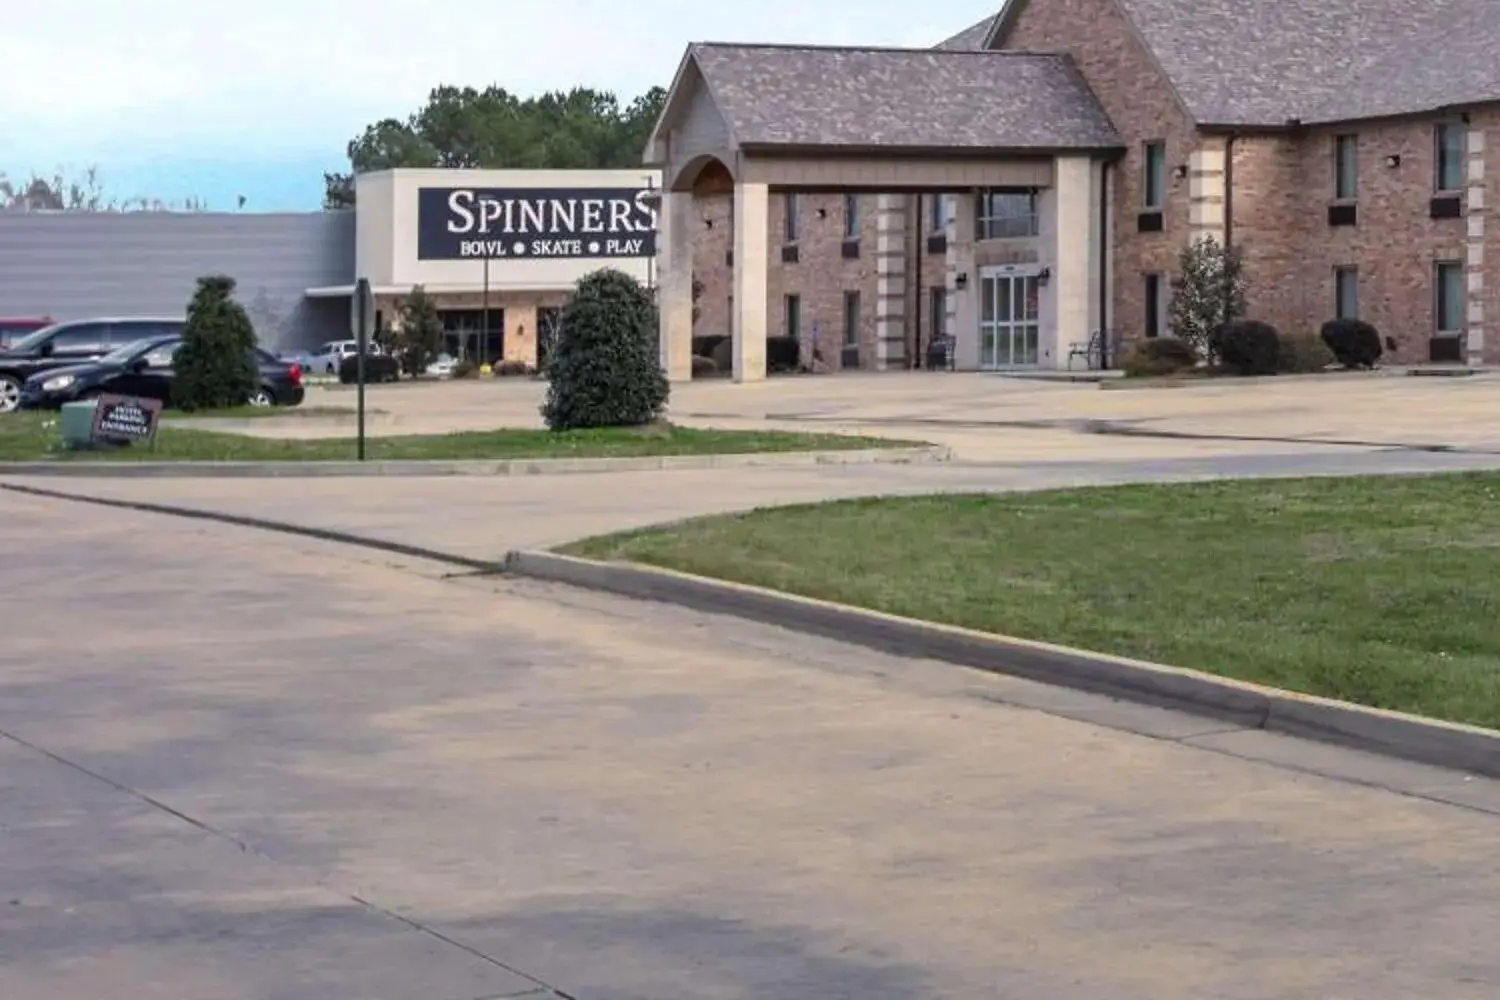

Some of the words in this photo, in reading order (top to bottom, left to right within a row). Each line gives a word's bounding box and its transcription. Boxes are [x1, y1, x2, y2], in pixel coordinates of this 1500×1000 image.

[447, 190, 657, 234] SPINNERS
[460, 241, 507, 256] BOWL
[531, 239, 582, 256] SKATE
[606, 239, 644, 255] PLAY
